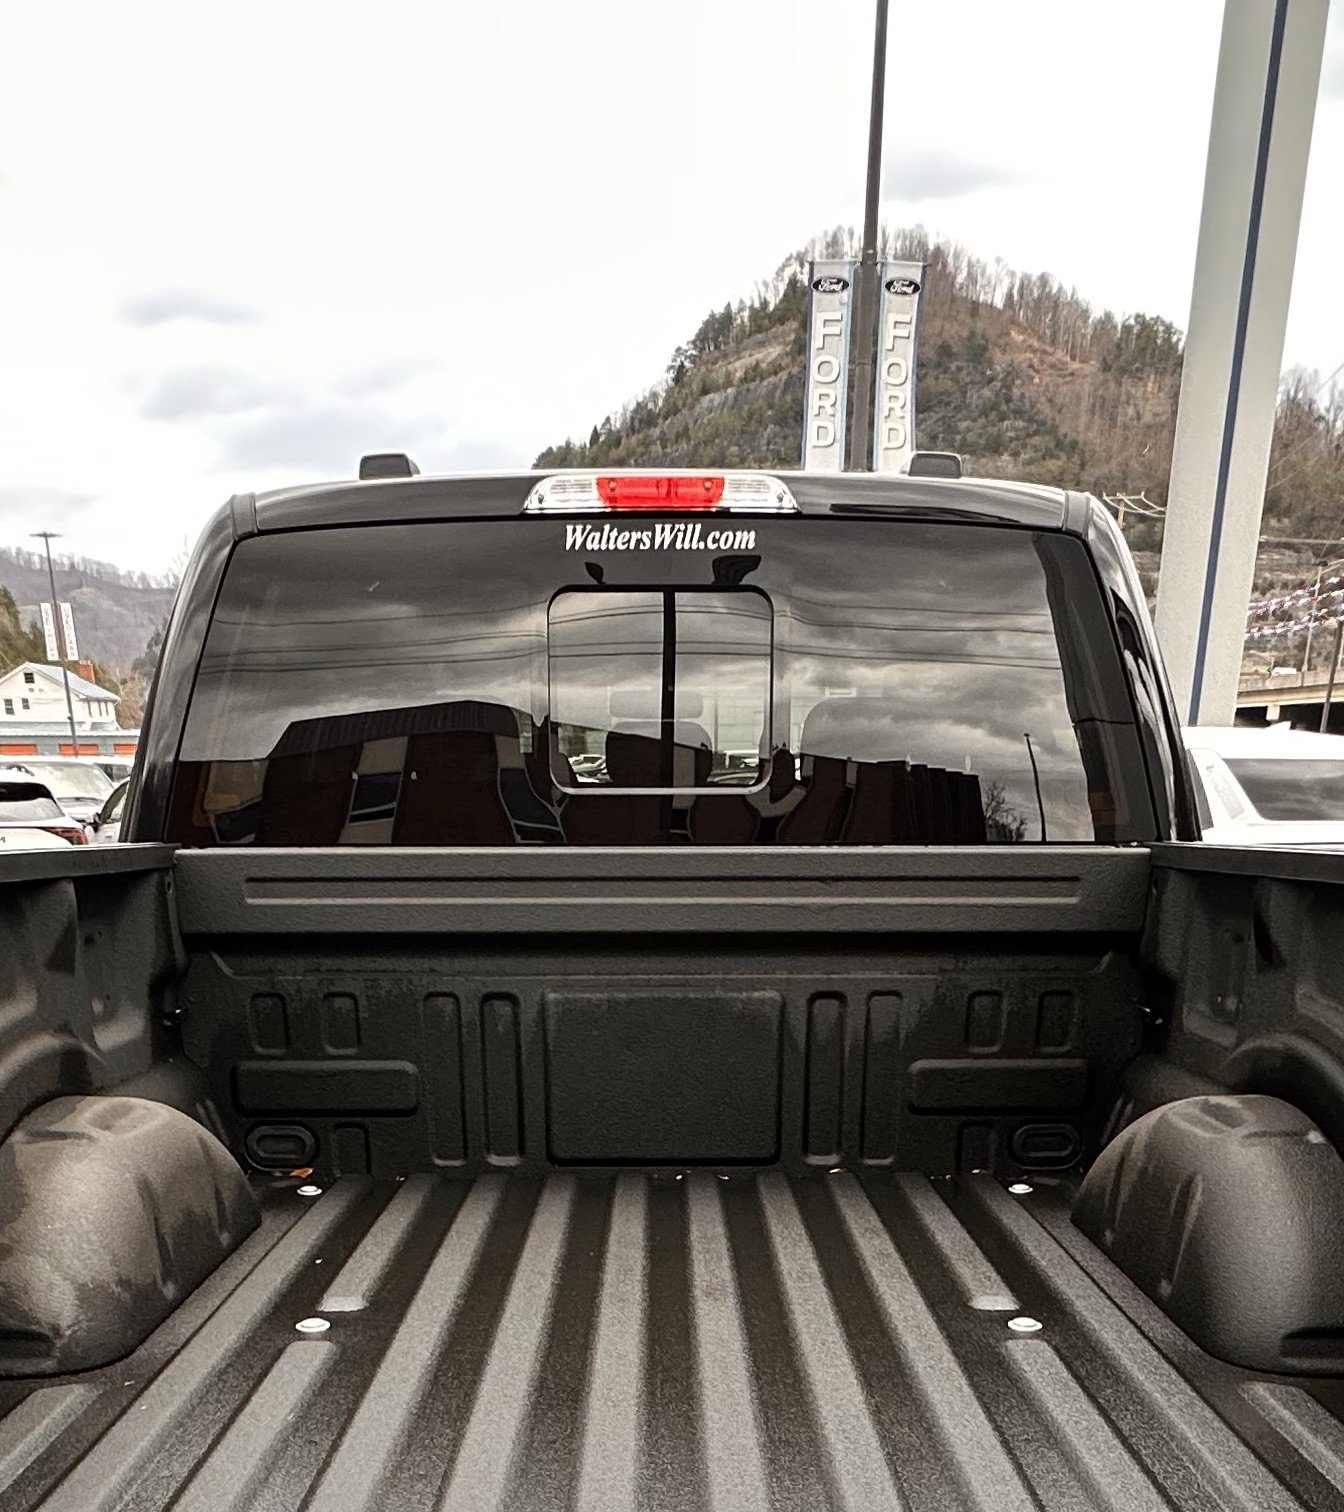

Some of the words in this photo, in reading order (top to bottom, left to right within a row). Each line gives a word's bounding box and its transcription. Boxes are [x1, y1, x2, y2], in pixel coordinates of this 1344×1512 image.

[811, 311, 843, 448] FORD
[883, 313, 913, 450] FORD
[565, 523, 756, 551] WaltersWill.com
